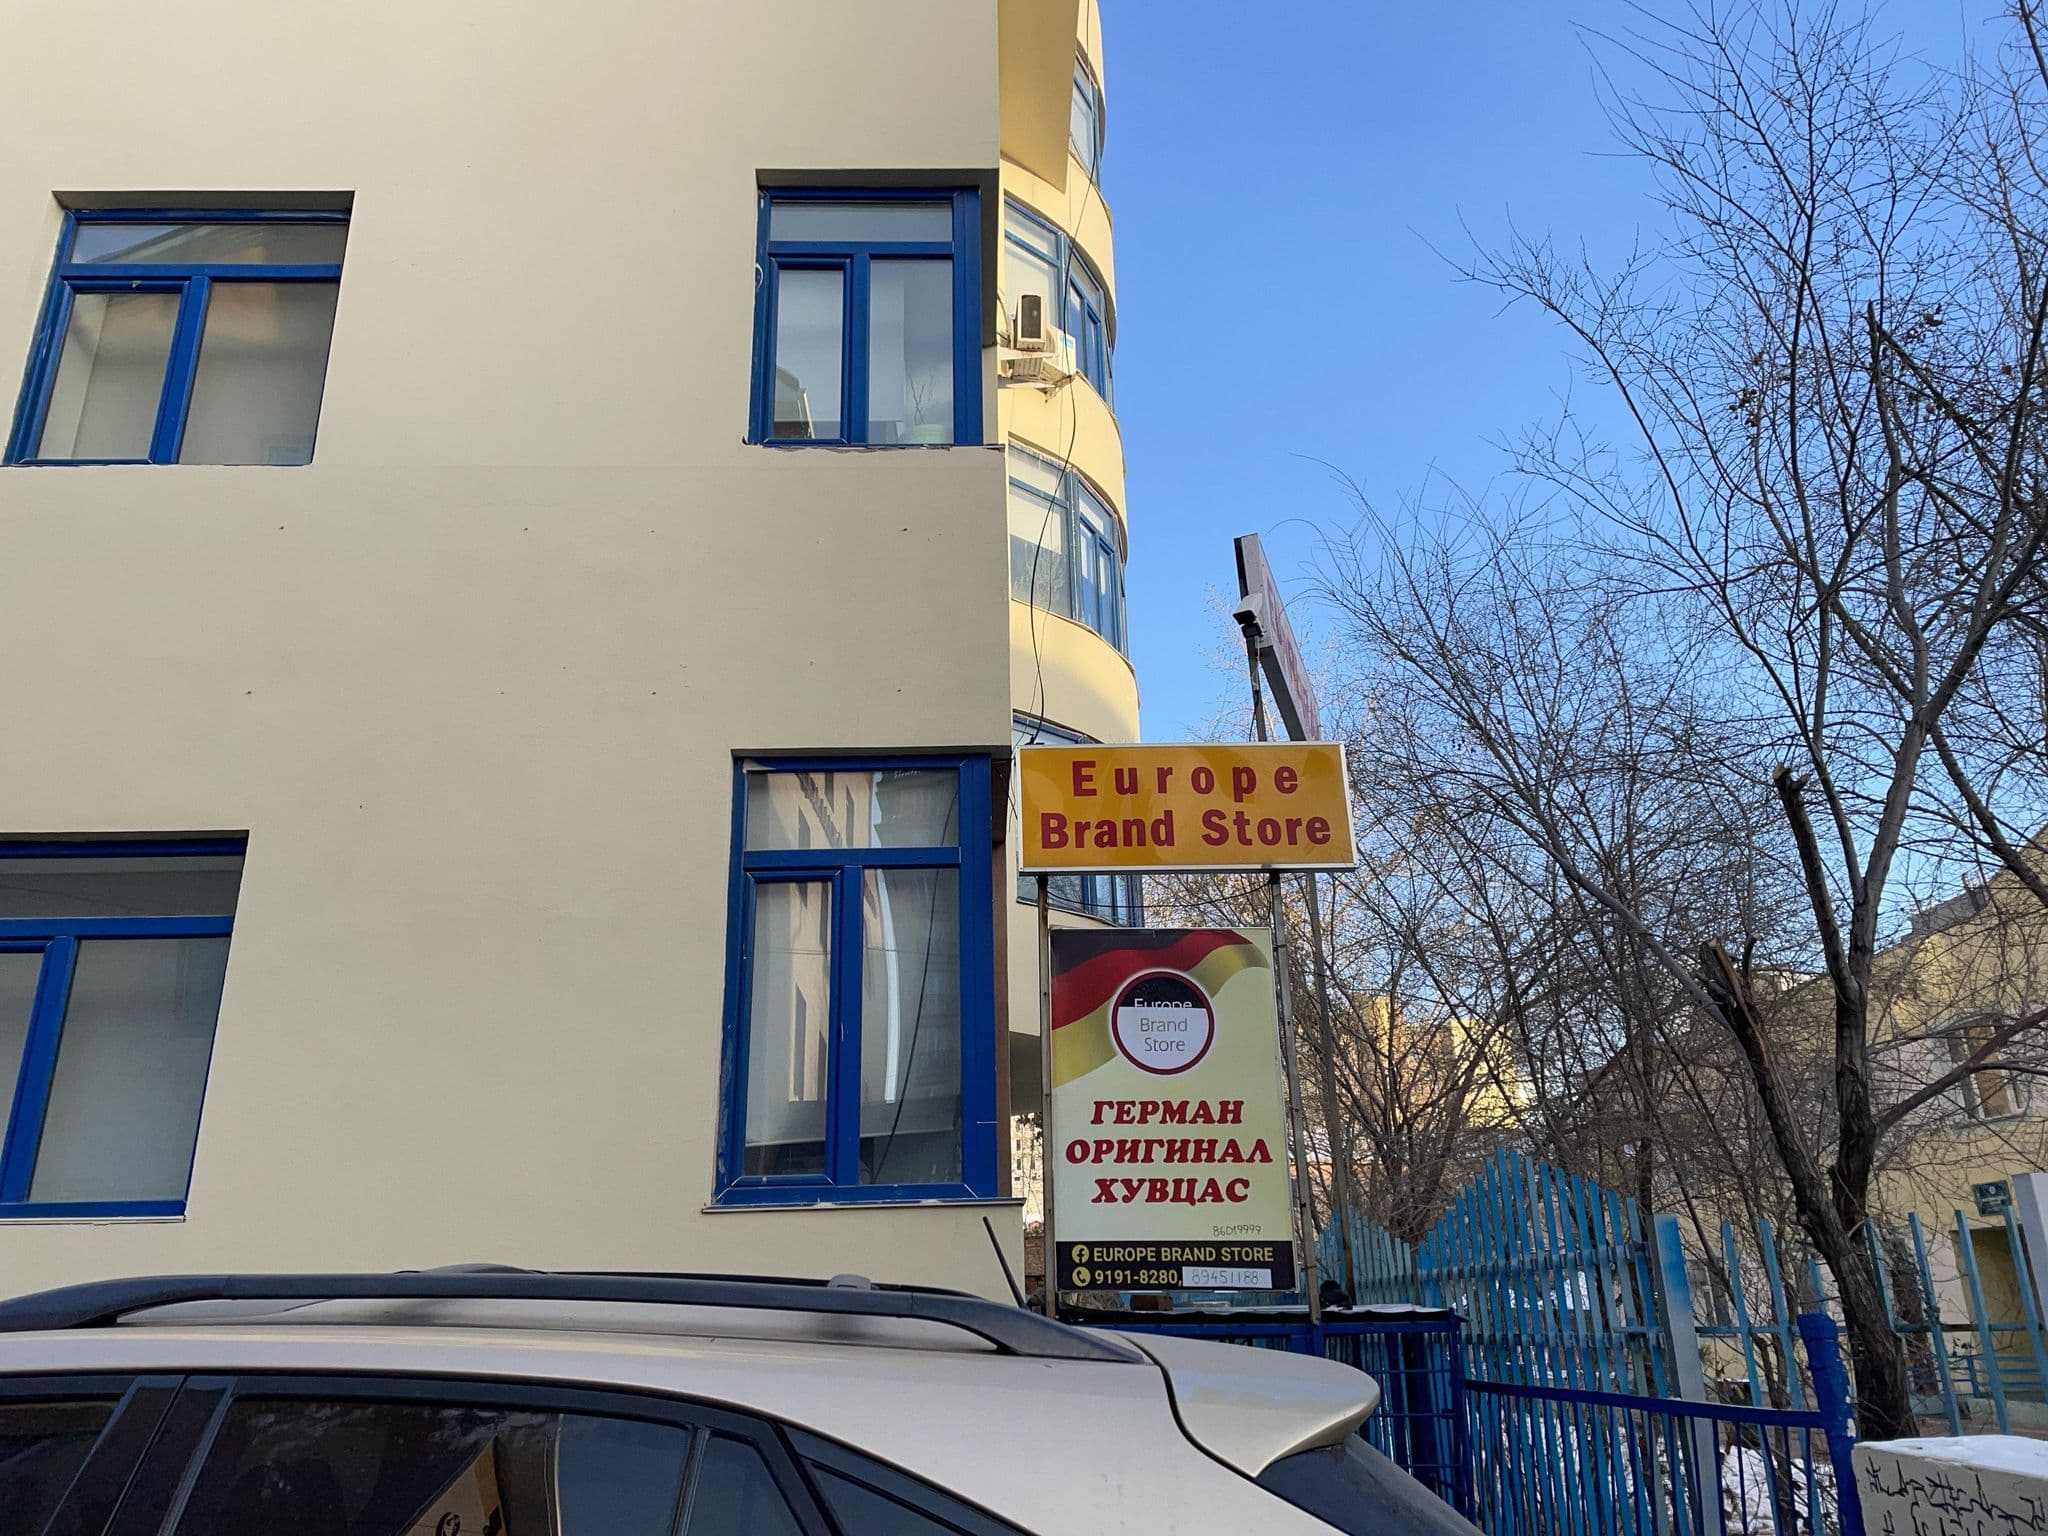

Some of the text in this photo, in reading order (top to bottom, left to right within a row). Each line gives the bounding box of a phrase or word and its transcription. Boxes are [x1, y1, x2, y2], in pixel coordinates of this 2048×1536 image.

[1072, 760, 1298, 802] Europe
[1041, 809, 1331, 849] Brand Store
[1140, 1017, 1188, 1033] Brand
[1144, 1037, 1186, 1052] Store
[1091, 1100, 1245, 1125] ГЕРМАН
[1065, 1138, 1273, 1164] ОРИГИНАЛ
[1091, 1178, 1250, 1206] ХУВЦАС
[1093, 1247, 1274, 1262] EUROPE BRAND STORE
[1094, 1269, 1183, 1287] 9191-8280,
